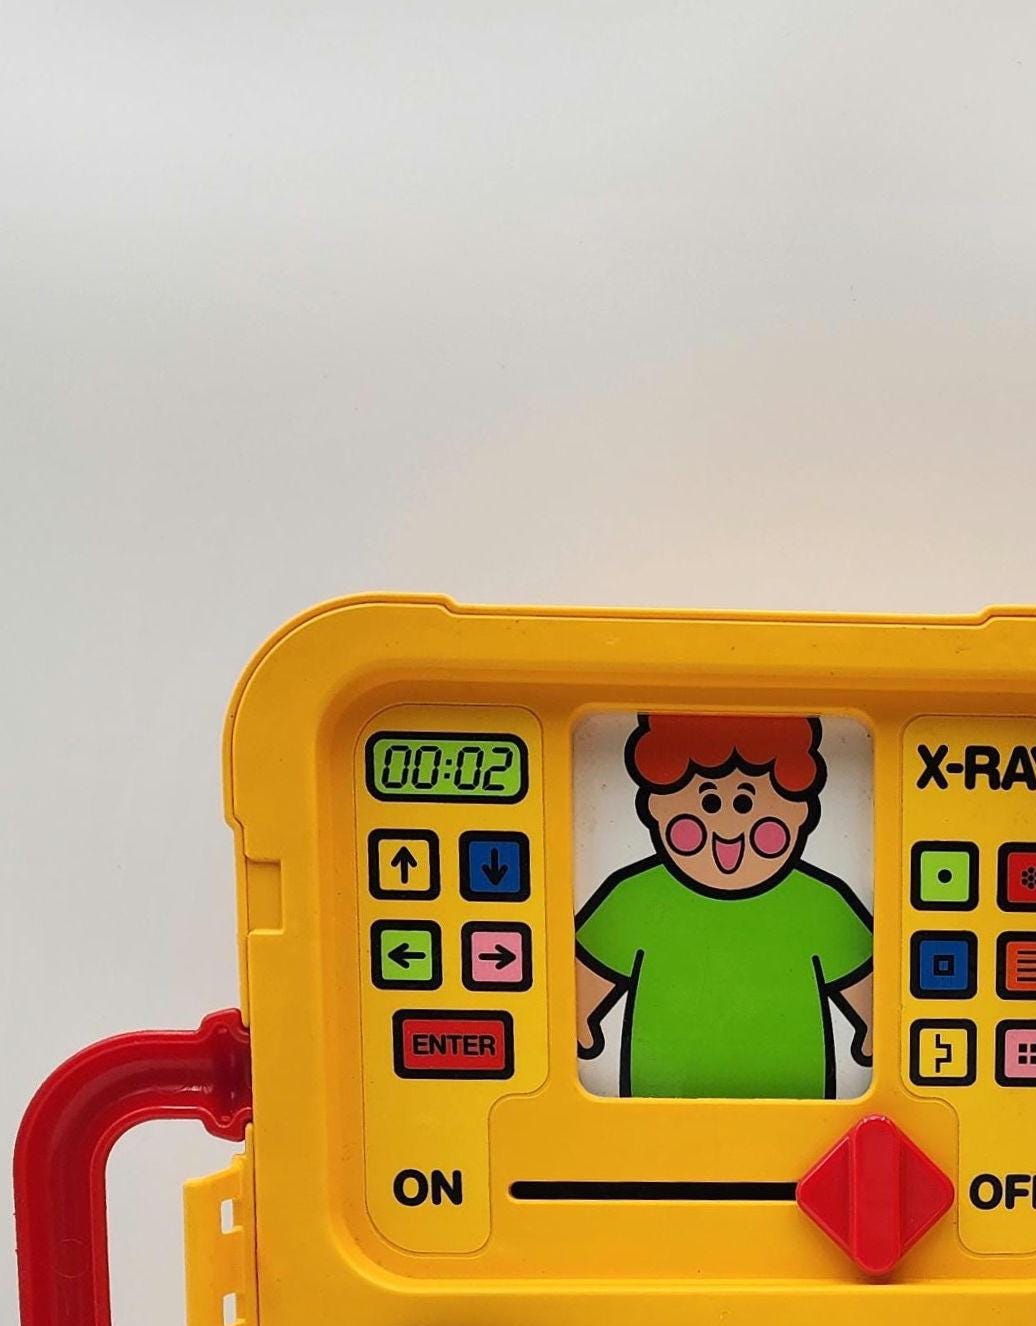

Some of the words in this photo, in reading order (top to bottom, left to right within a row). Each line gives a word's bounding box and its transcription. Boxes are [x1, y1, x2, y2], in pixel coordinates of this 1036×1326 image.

[380, 745, 513, 791] 00:02
[411, 1033, 497, 1057] ENTER
[392, 1167, 464, 1208] ON
